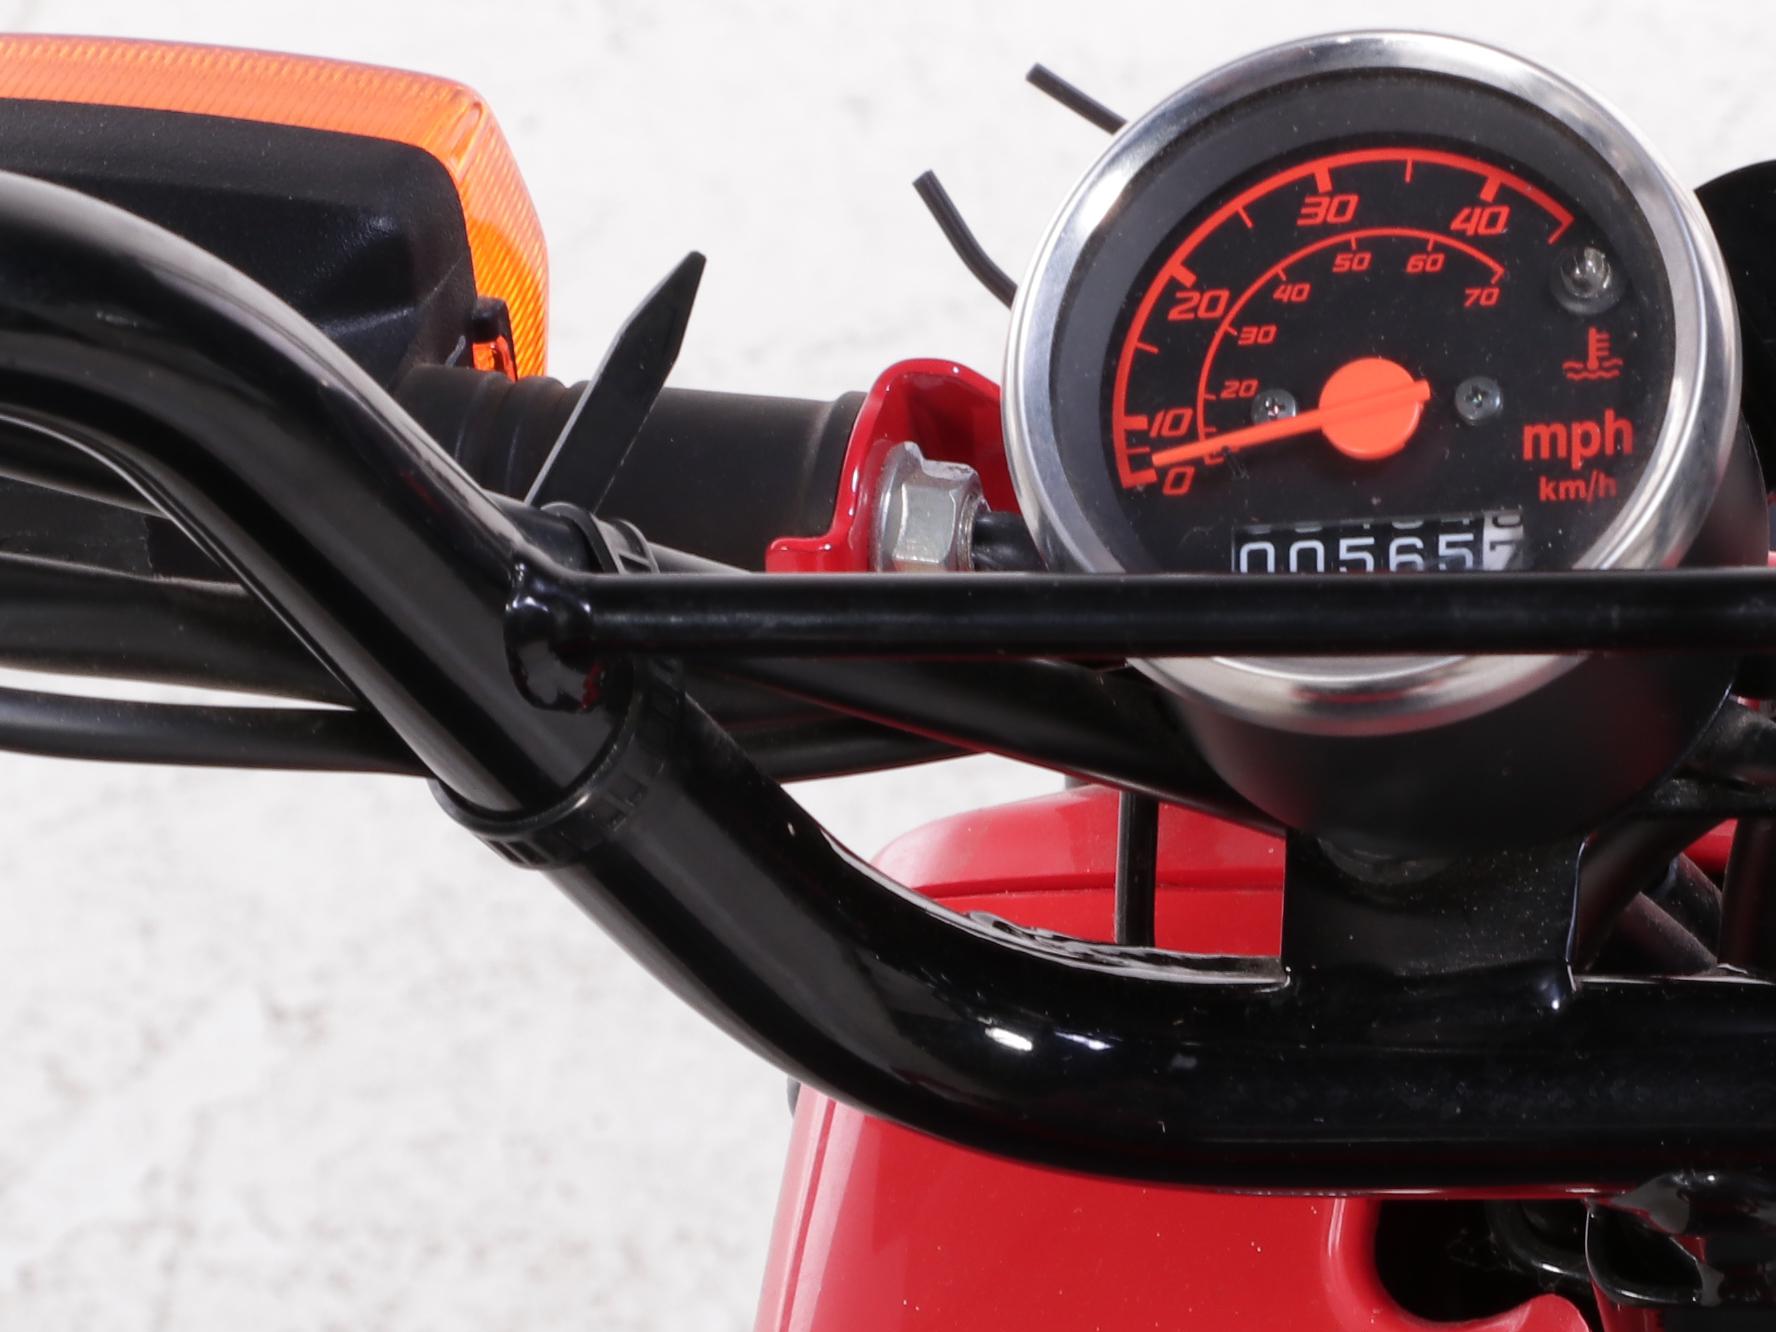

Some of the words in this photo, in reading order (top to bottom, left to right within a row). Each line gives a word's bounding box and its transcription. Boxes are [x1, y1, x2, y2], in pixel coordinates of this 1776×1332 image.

[1297, 193, 1360, 226] 30
[1450, 205, 1511, 237] 40
[1332, 251, 1372, 274] 50
[1405, 251, 1446, 274] 60
[1168, 288, 1231, 321] 20
[1272, 281, 1311, 304] 40
[1464, 286, 1500, 307] 70
[1237, 324, 1278, 346] 30
[1219, 378, 1260, 400] 20
[1149, 406, 1194, 438] 10
[1523, 409, 1634, 470] mph
[1162, 465, 1196, 496] 0
[1539, 470, 1617, 502] km/h
